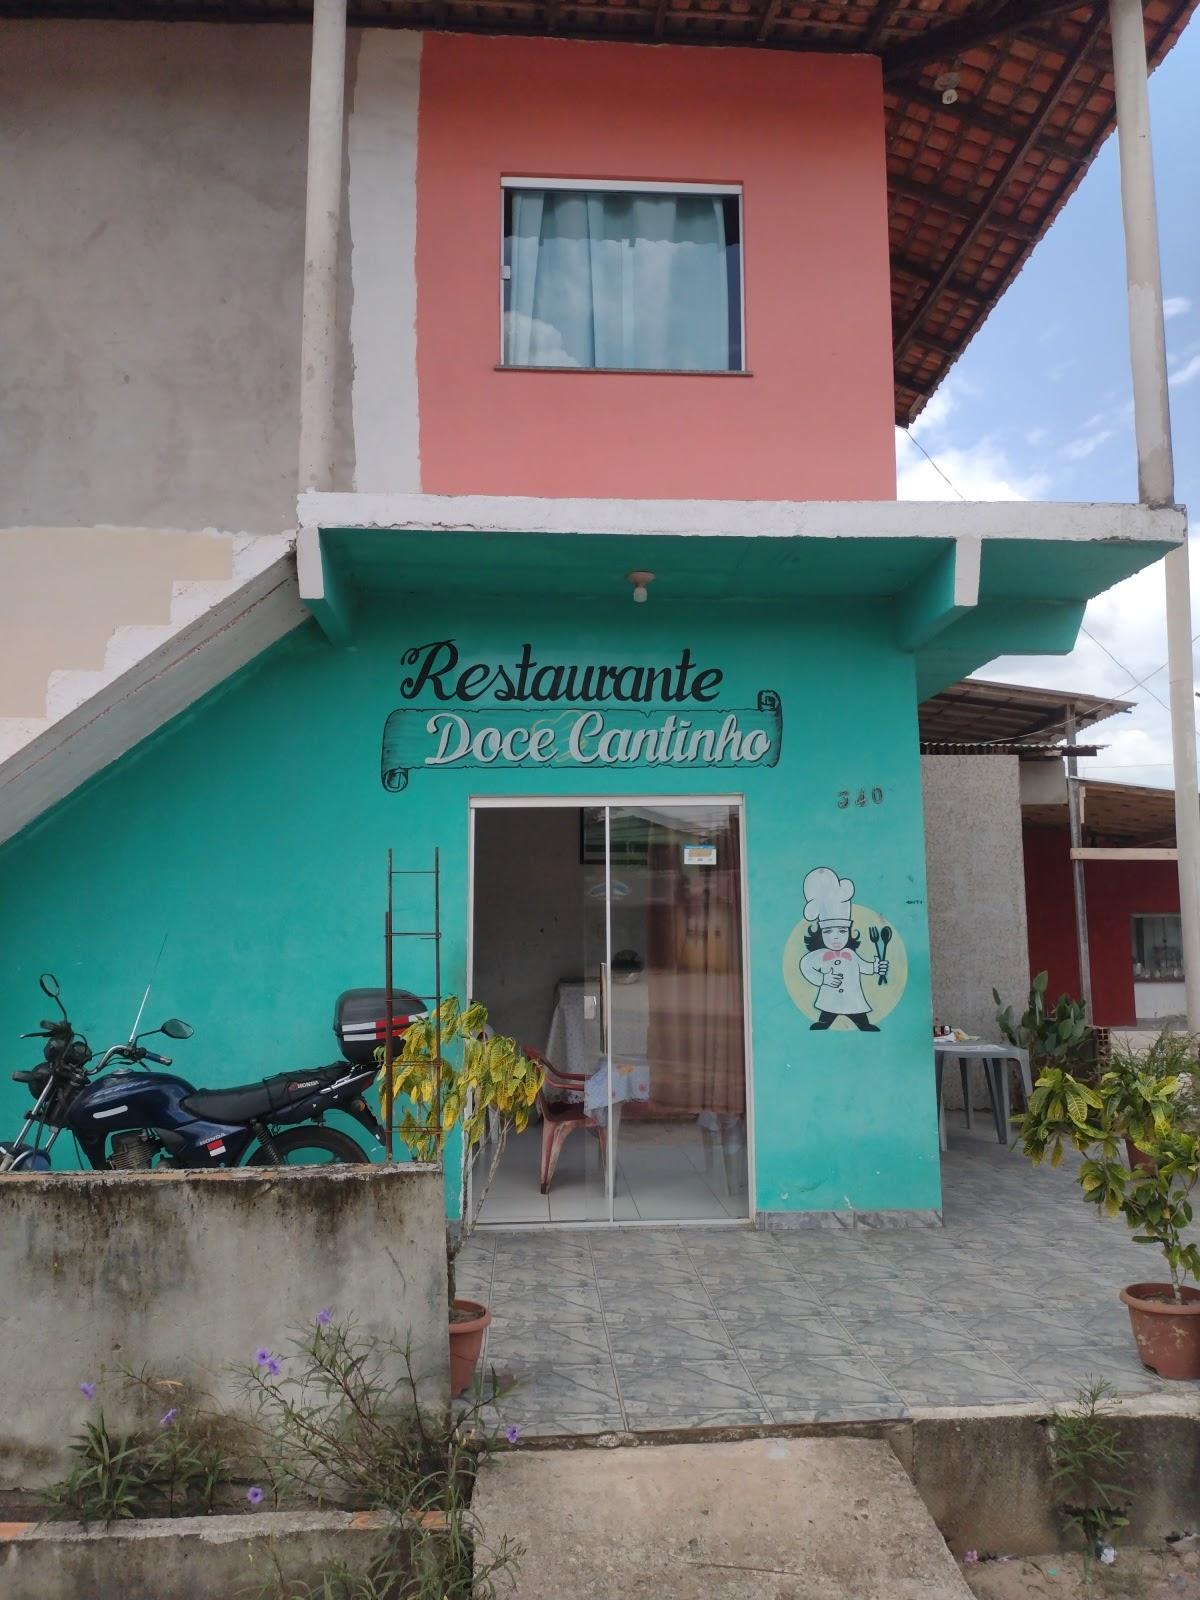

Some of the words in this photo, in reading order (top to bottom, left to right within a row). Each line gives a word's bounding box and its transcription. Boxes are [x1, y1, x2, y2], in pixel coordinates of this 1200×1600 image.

[400, 638, 723, 702] Restaurante
[425, 712, 557, 765] Doce
[569, 710, 772, 764] Cantinho
[297, 1080, 320, 1089] HONDA
[199, 1132, 226, 1146] HONDA
